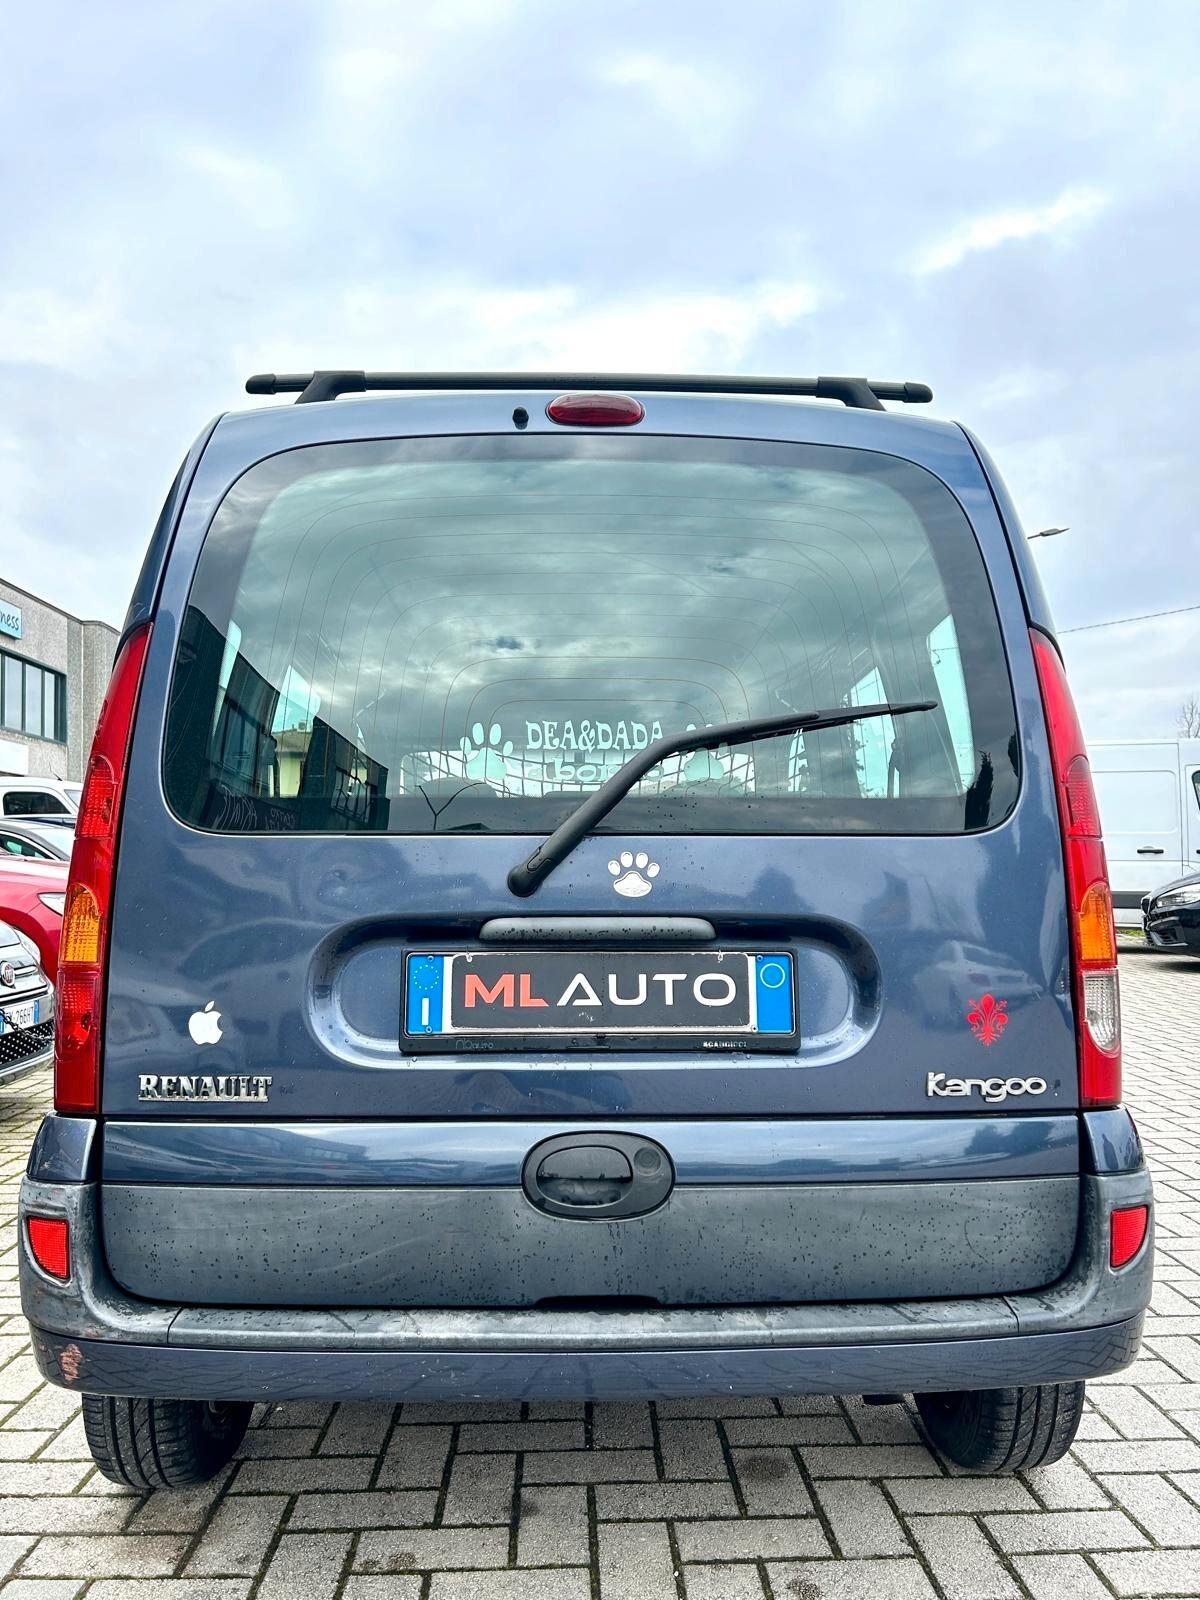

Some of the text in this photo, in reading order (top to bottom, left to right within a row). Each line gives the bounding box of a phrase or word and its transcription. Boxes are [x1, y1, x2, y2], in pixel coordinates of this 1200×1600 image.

[525, 720, 664, 753] DEA&DADA
[464, 972, 737, 1008] ML AUTO
[138, 1074, 273, 1102] RENAULT
[927, 1072, 1048, 1103] Kangoo
